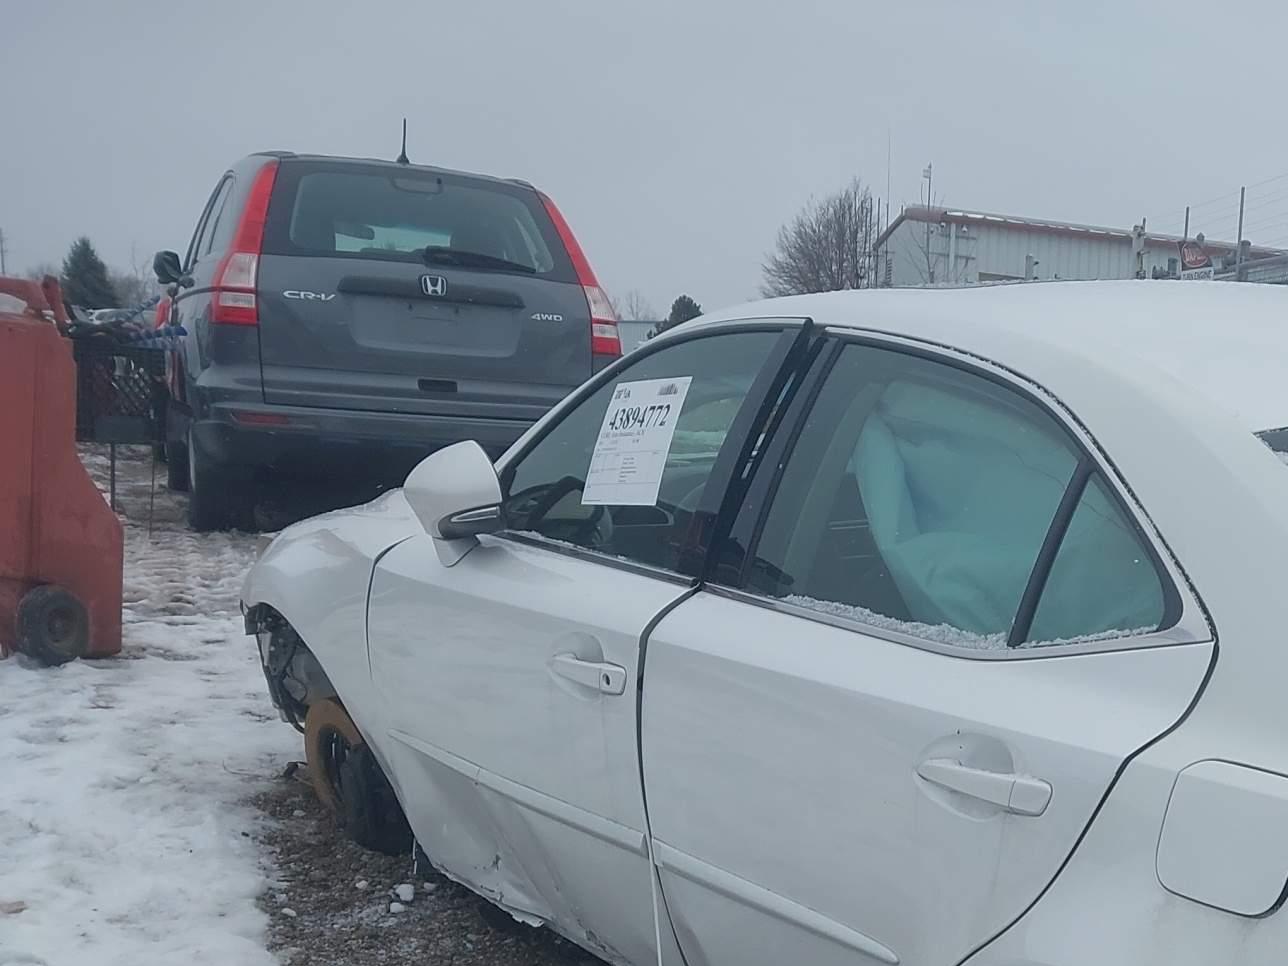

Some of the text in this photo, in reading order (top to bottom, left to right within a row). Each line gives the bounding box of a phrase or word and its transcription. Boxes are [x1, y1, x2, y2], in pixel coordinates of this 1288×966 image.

[282, 290, 337, 301] CR-V
[530, 313, 563, 322] 4WD
[608, 404, 671, 431] 43894772
